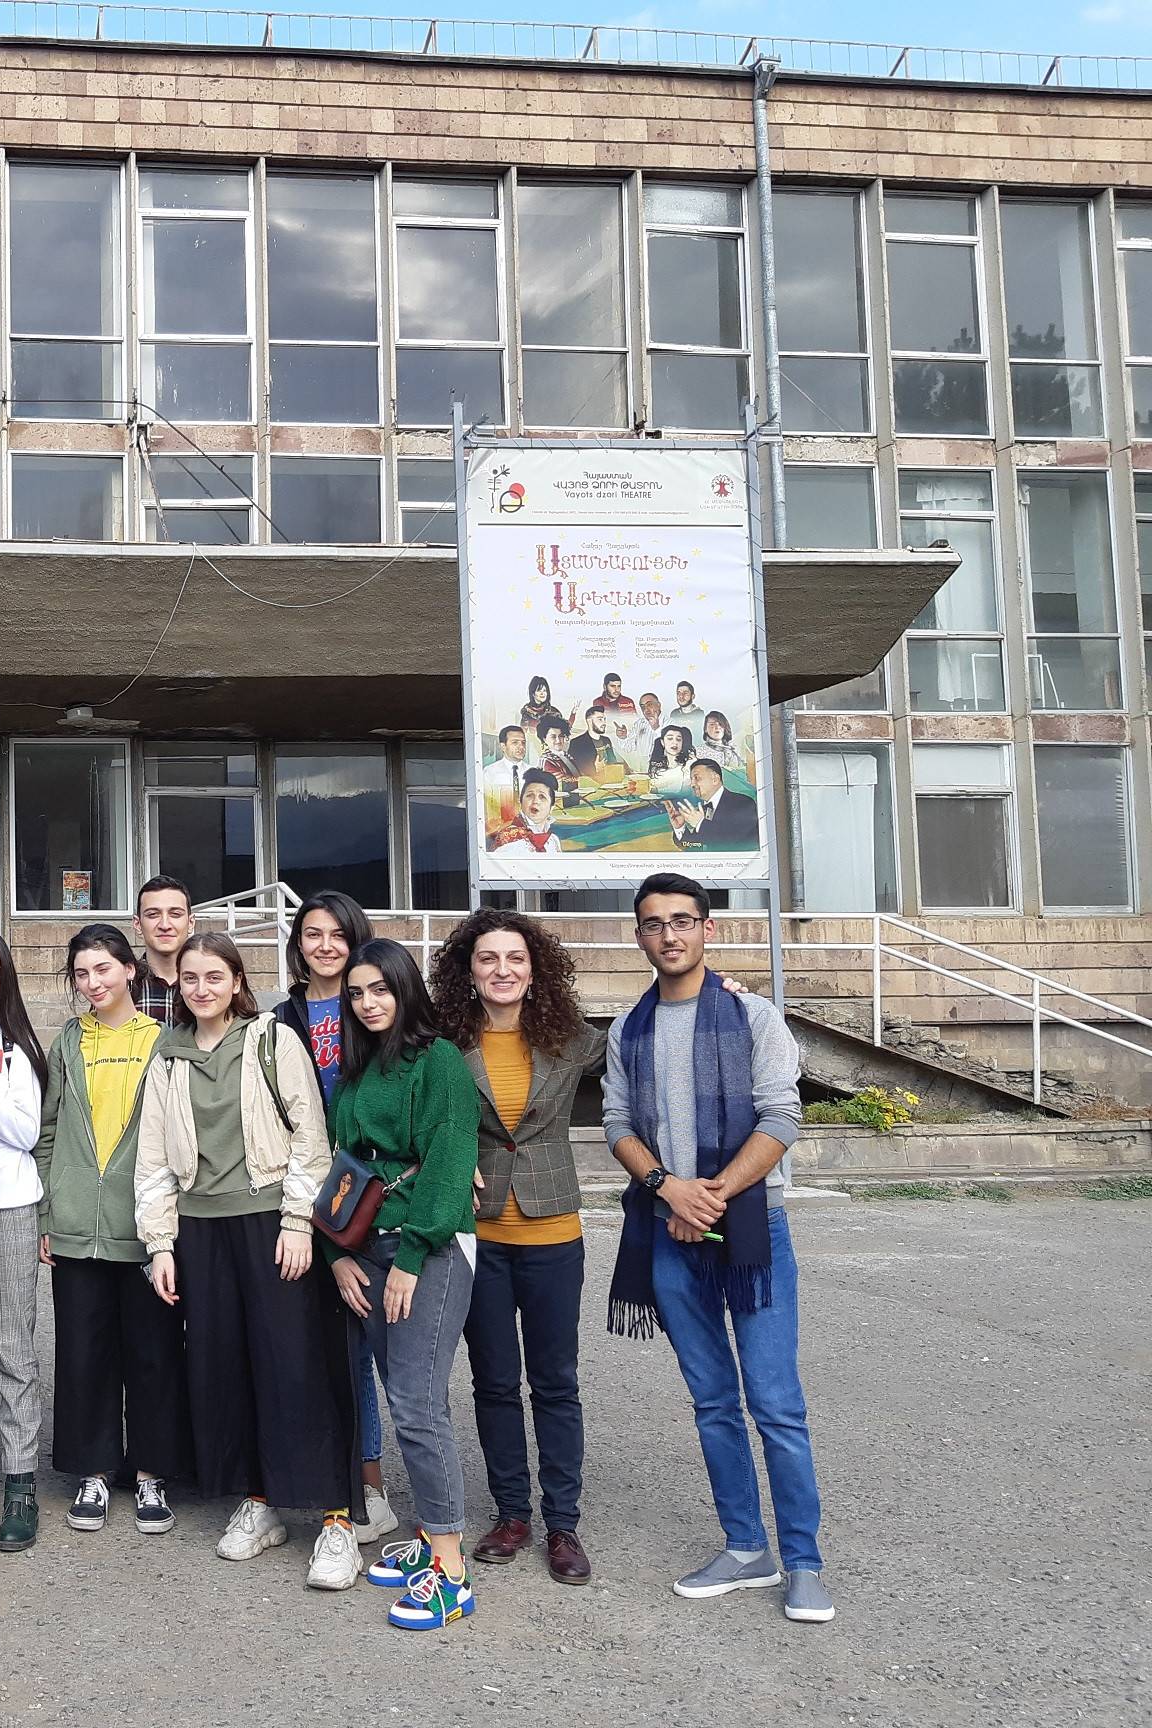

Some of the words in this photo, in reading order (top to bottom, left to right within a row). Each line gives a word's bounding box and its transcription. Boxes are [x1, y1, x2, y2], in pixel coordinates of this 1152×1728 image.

[552, 481, 589, 490] ՎԱՅՈՑ
[591, 481, 619, 490] ՁՈՐԻ
[620, 481, 663, 490] ԹԱՏՐՈՆ
[565, 491, 593, 500] Vayots
[596, 490, 618, 499] dzori
[620, 491, 652, 499] THEATRE
